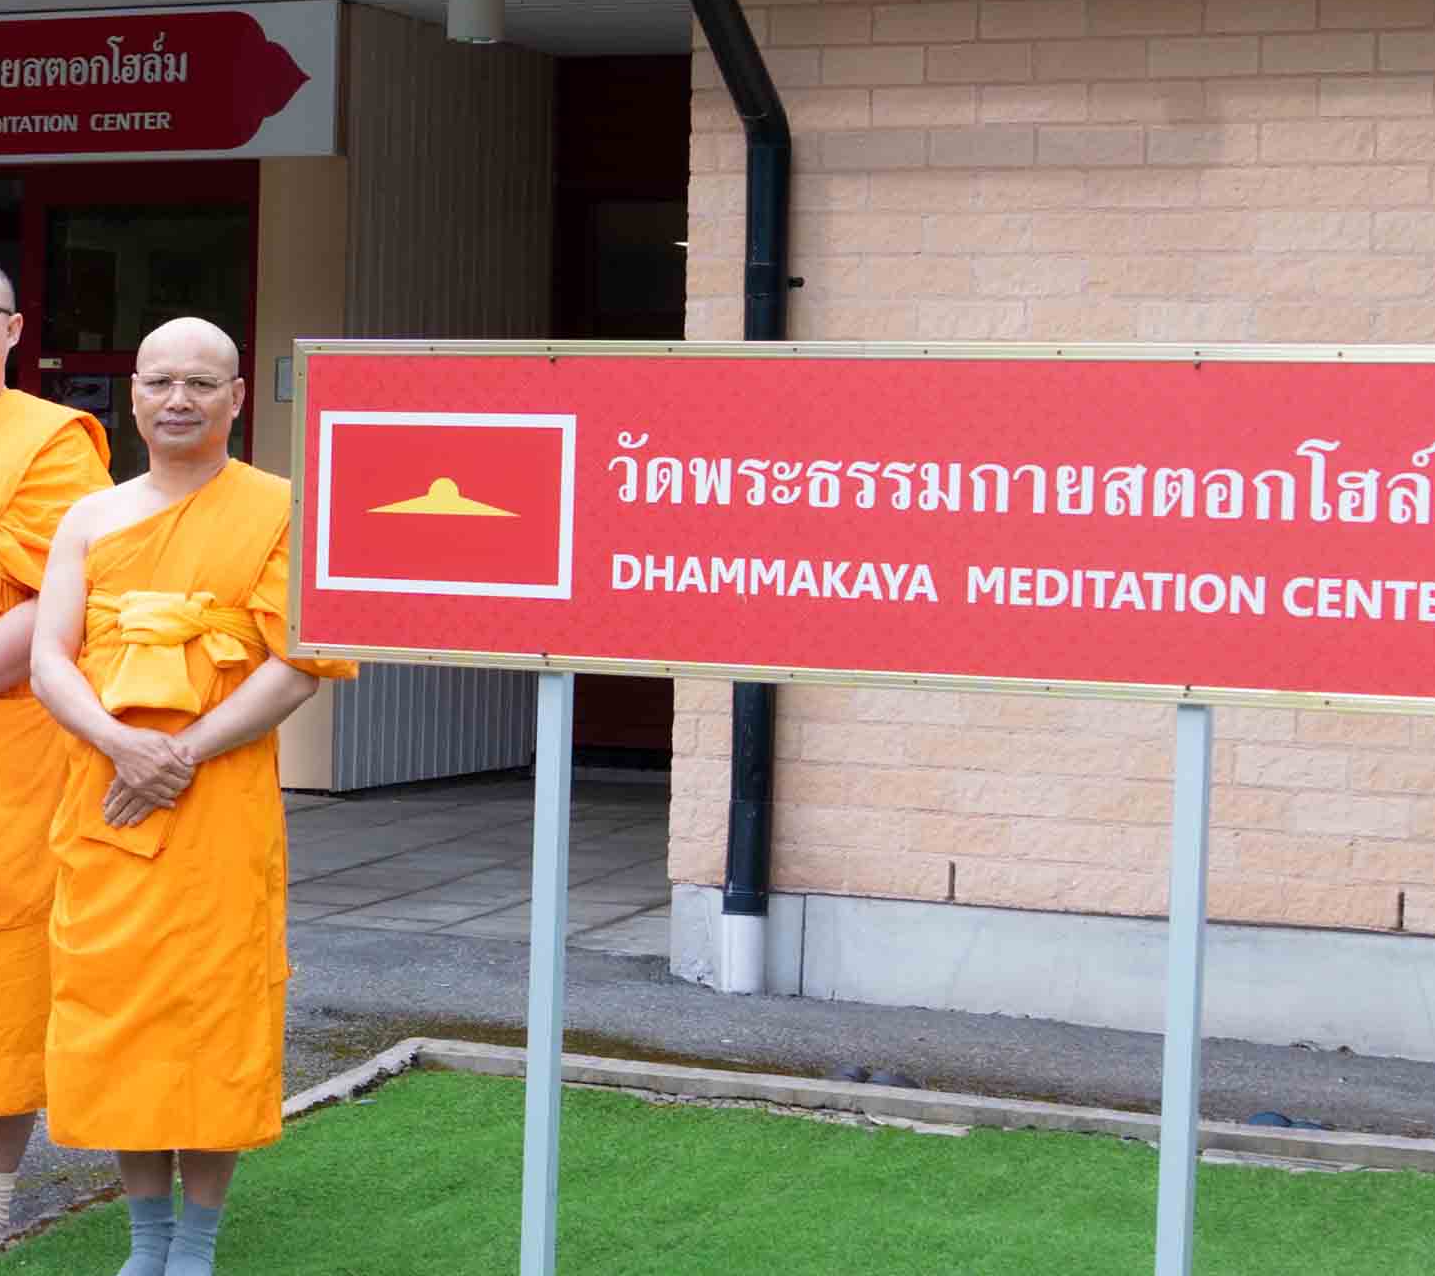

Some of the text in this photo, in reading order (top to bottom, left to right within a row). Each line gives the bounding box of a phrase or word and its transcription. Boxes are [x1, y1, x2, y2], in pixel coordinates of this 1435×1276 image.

[90, 111, 171, 131] CENTER
[611, 553, 939, 603] DHAMMAKAYA
[966, 565, 1267, 616] MEDITATION
